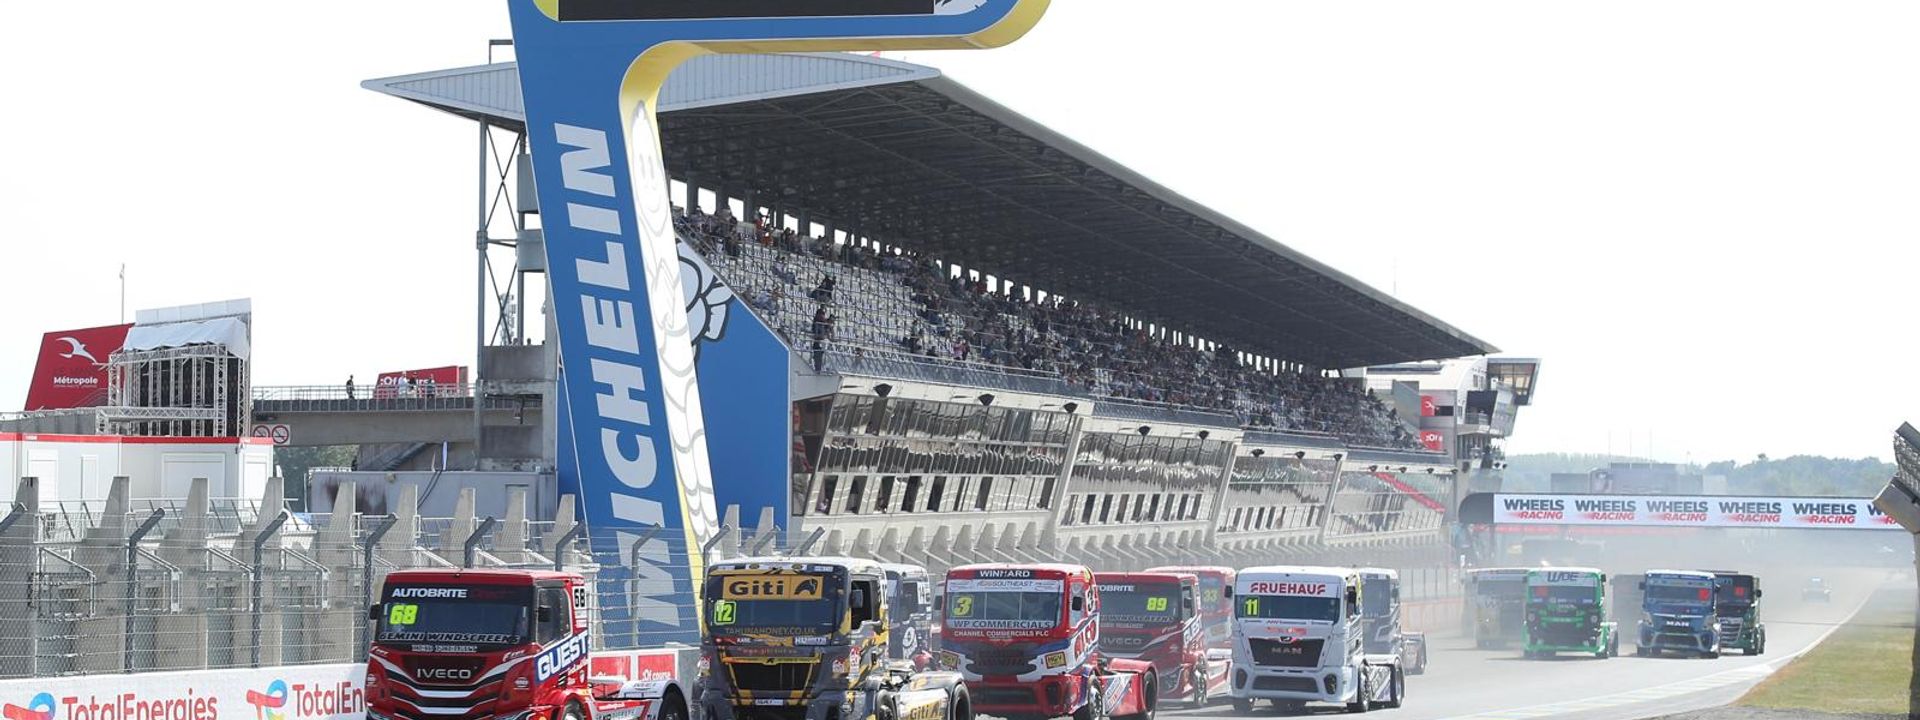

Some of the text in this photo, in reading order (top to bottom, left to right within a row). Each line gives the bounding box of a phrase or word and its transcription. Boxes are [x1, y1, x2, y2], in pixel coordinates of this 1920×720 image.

[553, 121, 680, 627] MICHELIN
[53, 376, 99, 386] Métropole
[1504, 499, 1564, 512] WHEELS
[1575, 500, 1636, 513] WHEELS
[1647, 501, 1709, 514] WHEELS
[1718, 502, 1781, 514] WHEELS
[1793, 503, 1857, 515] WHEELS
[1519, 511, 1562, 520] RACING
[1591, 512, 1633, 521] RACING
[1663, 513, 1707, 522] RACING
[1735, 514, 1780, 523] RACING
[1810, 515, 1855, 524] RACING
[392, 588, 468, 598] AUTOBRITE
[728, 580, 784, 596] Giti
[1250, 582, 1326, 595] FRUEHAUF
[574, 588, 585, 607] 68
[1146, 597, 1168, 611] 89
[716, 603, 733, 622] 12
[953, 597, 972, 616] 3
[1244, 598, 1259, 616] 11
[390, 605, 419, 625] 68
[972, 620, 1052, 629] COMMERCIALS
[986, 630, 1034, 638] COMMERCIALS
[537, 634, 588, 682] GUEST
[417, 668, 471, 679] IVECO
[292, 681, 364, 718] TotalEn
